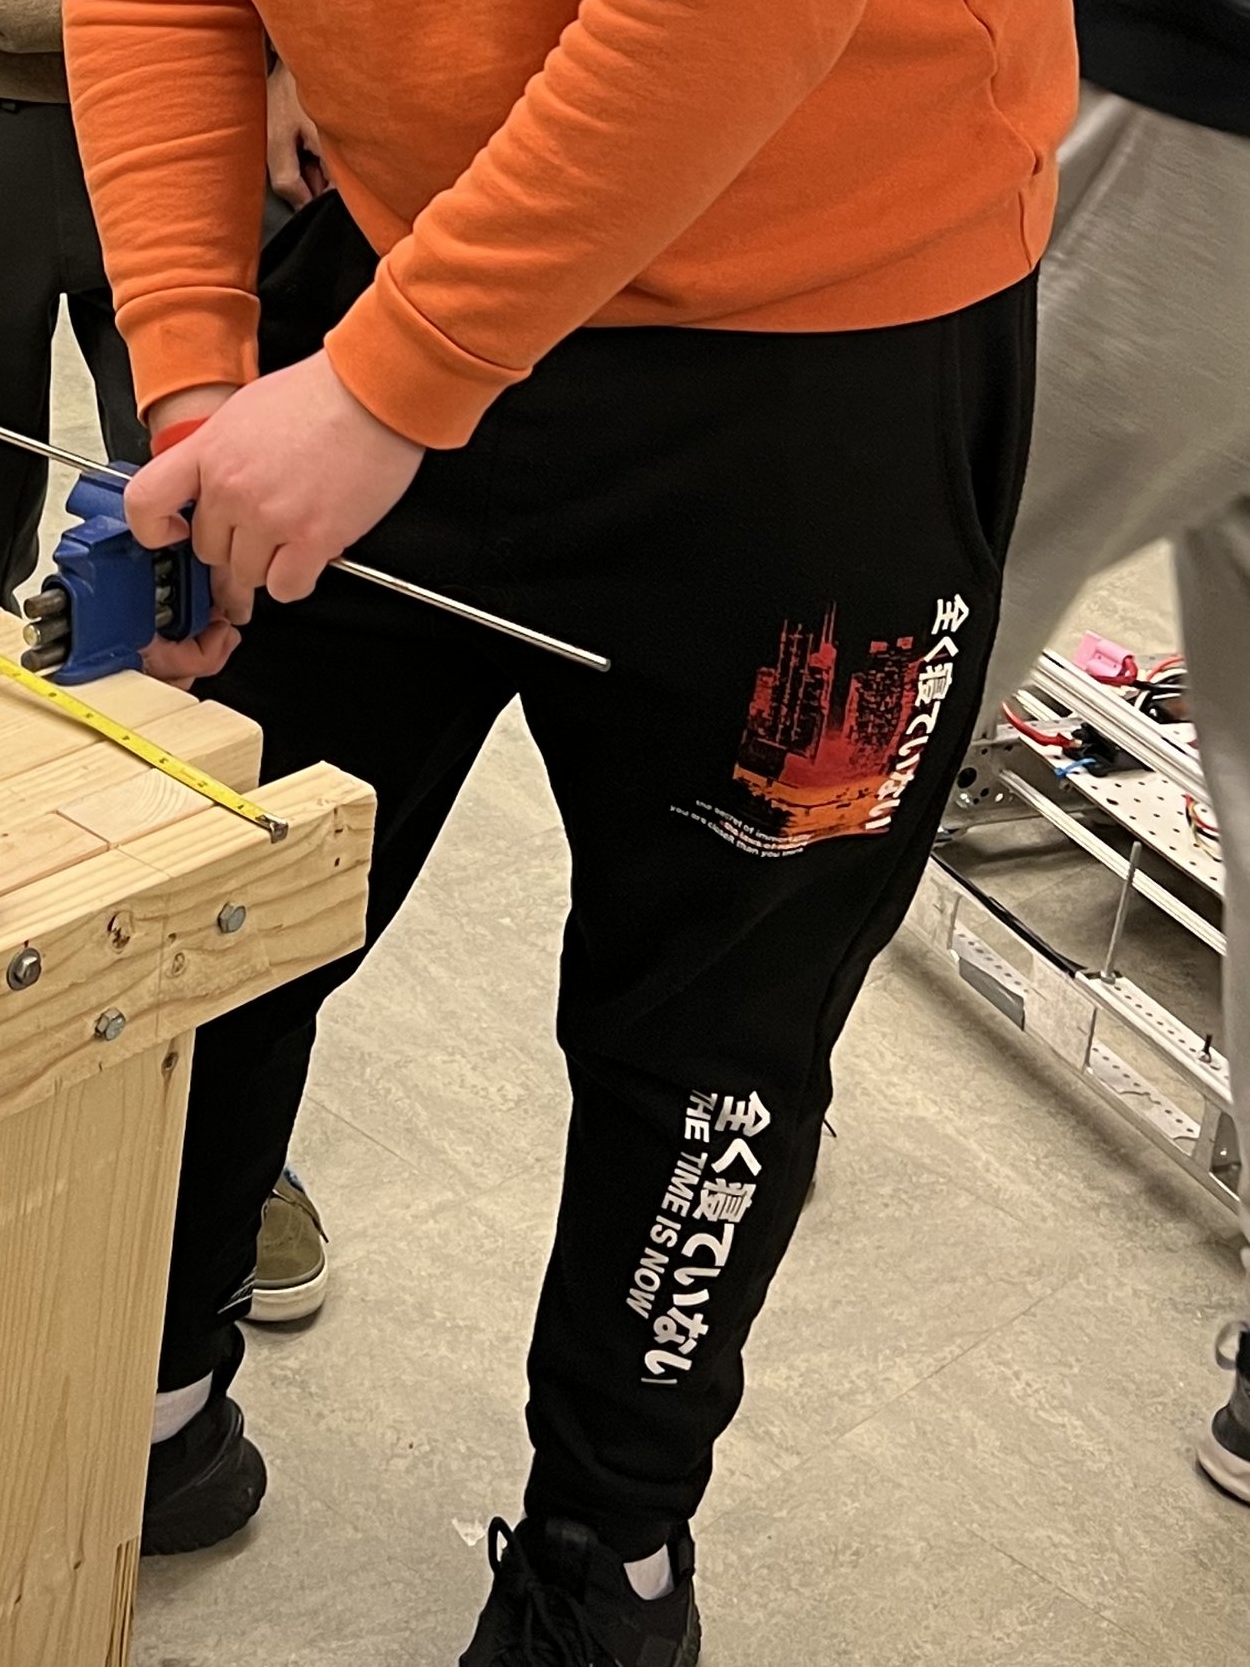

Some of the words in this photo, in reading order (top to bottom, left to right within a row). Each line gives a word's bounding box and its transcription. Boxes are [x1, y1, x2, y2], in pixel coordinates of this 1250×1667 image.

[684, 1089, 718, 1143] THE
[661, 1151, 708, 1217] TIME
[641, 1090, 771, 1384] 全く寝ていない
[650, 1214, 682, 1248] IS
[626, 1247, 669, 1319] NOW
